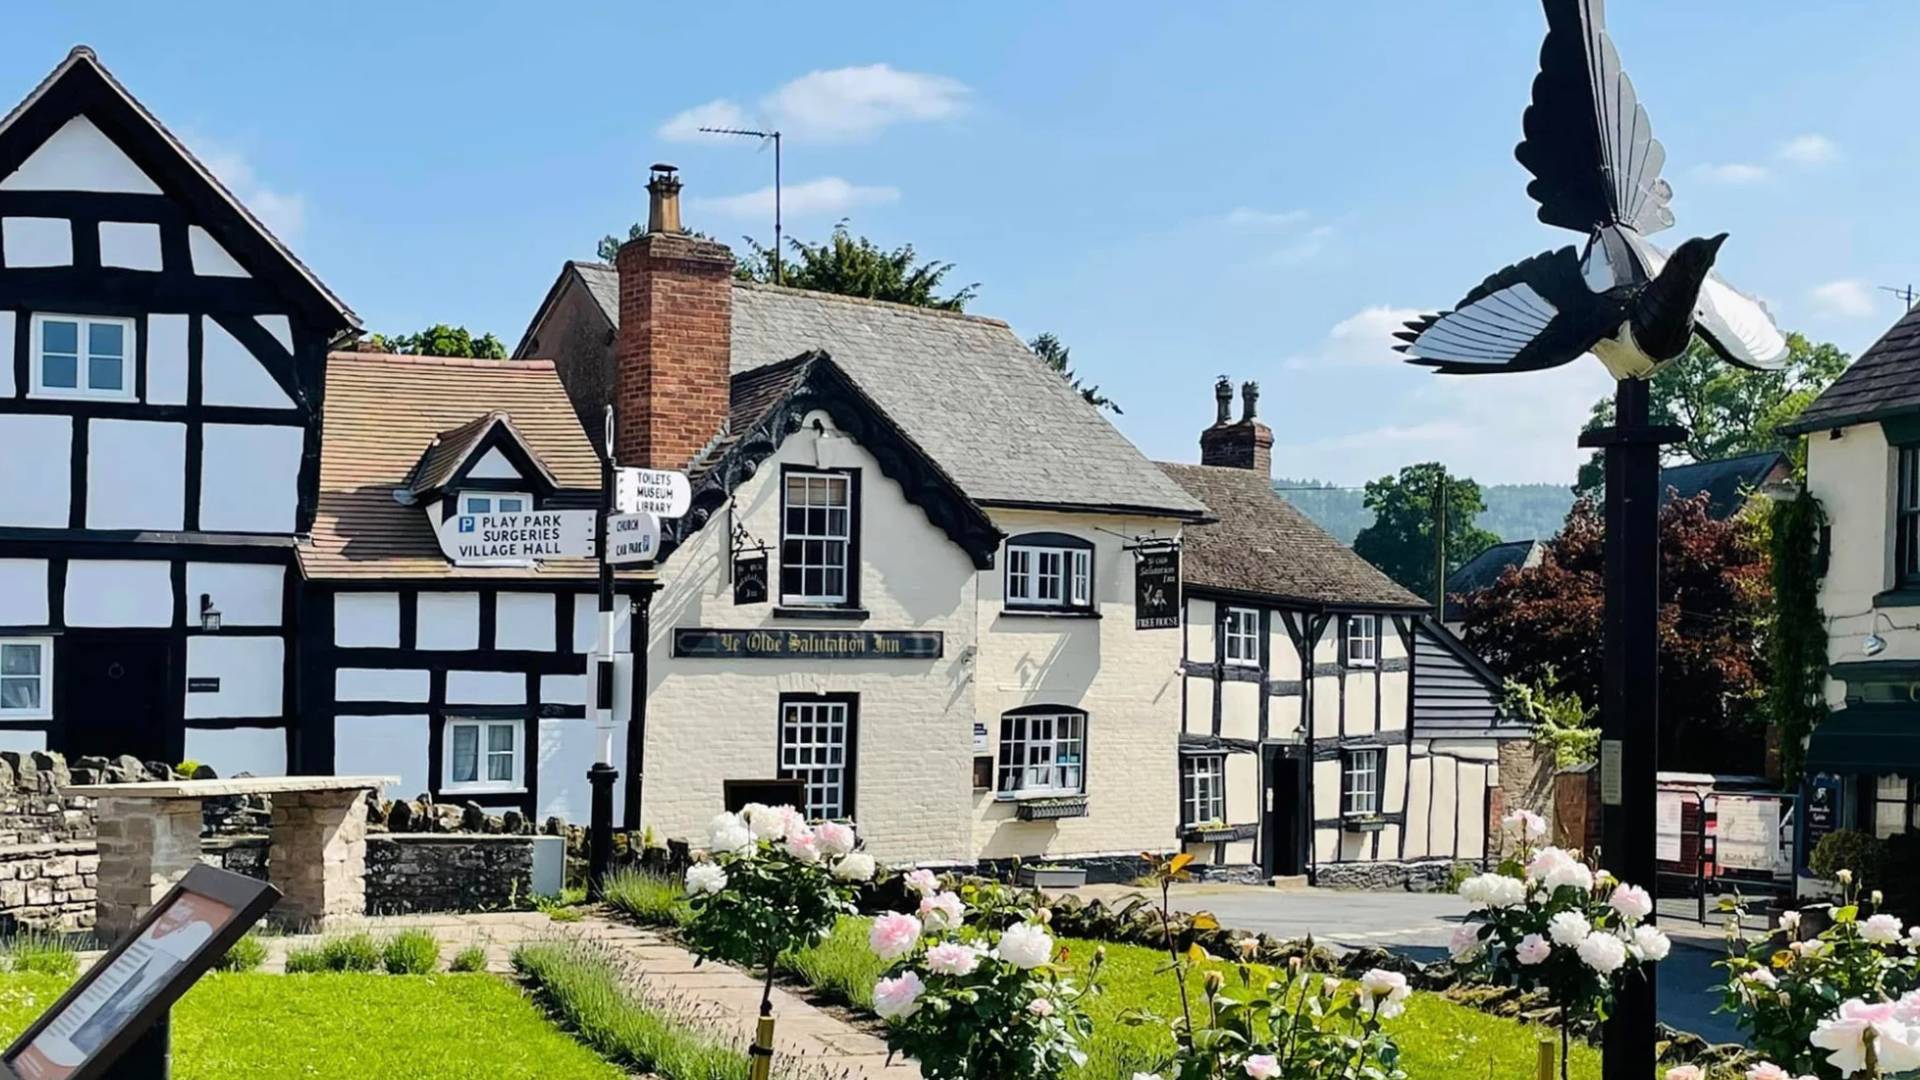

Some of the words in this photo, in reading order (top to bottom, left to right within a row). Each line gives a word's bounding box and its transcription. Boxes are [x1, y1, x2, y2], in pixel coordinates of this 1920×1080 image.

[637, 472, 672, 486] TOILETS
[637, 487, 673, 499] MUSEUM
[636, 501, 672, 513] LIBRARY
[483, 516, 518, 528] PLAY
[524, 515, 562, 527] PARK
[616, 519, 639, 532] CHURCH
[483, 528, 560, 542] SURGERIES
[459, 544, 517, 557] VILLAGE
[523, 542, 561, 555] HALL
[616, 544, 627, 556] CAR
[629, 542, 642, 554] PARK
[721, 632, 741, 652] Ye
[746, 630, 782, 653] Olde
[788, 631, 866, 653] Salutation
[874, 633, 900, 653] Inn
